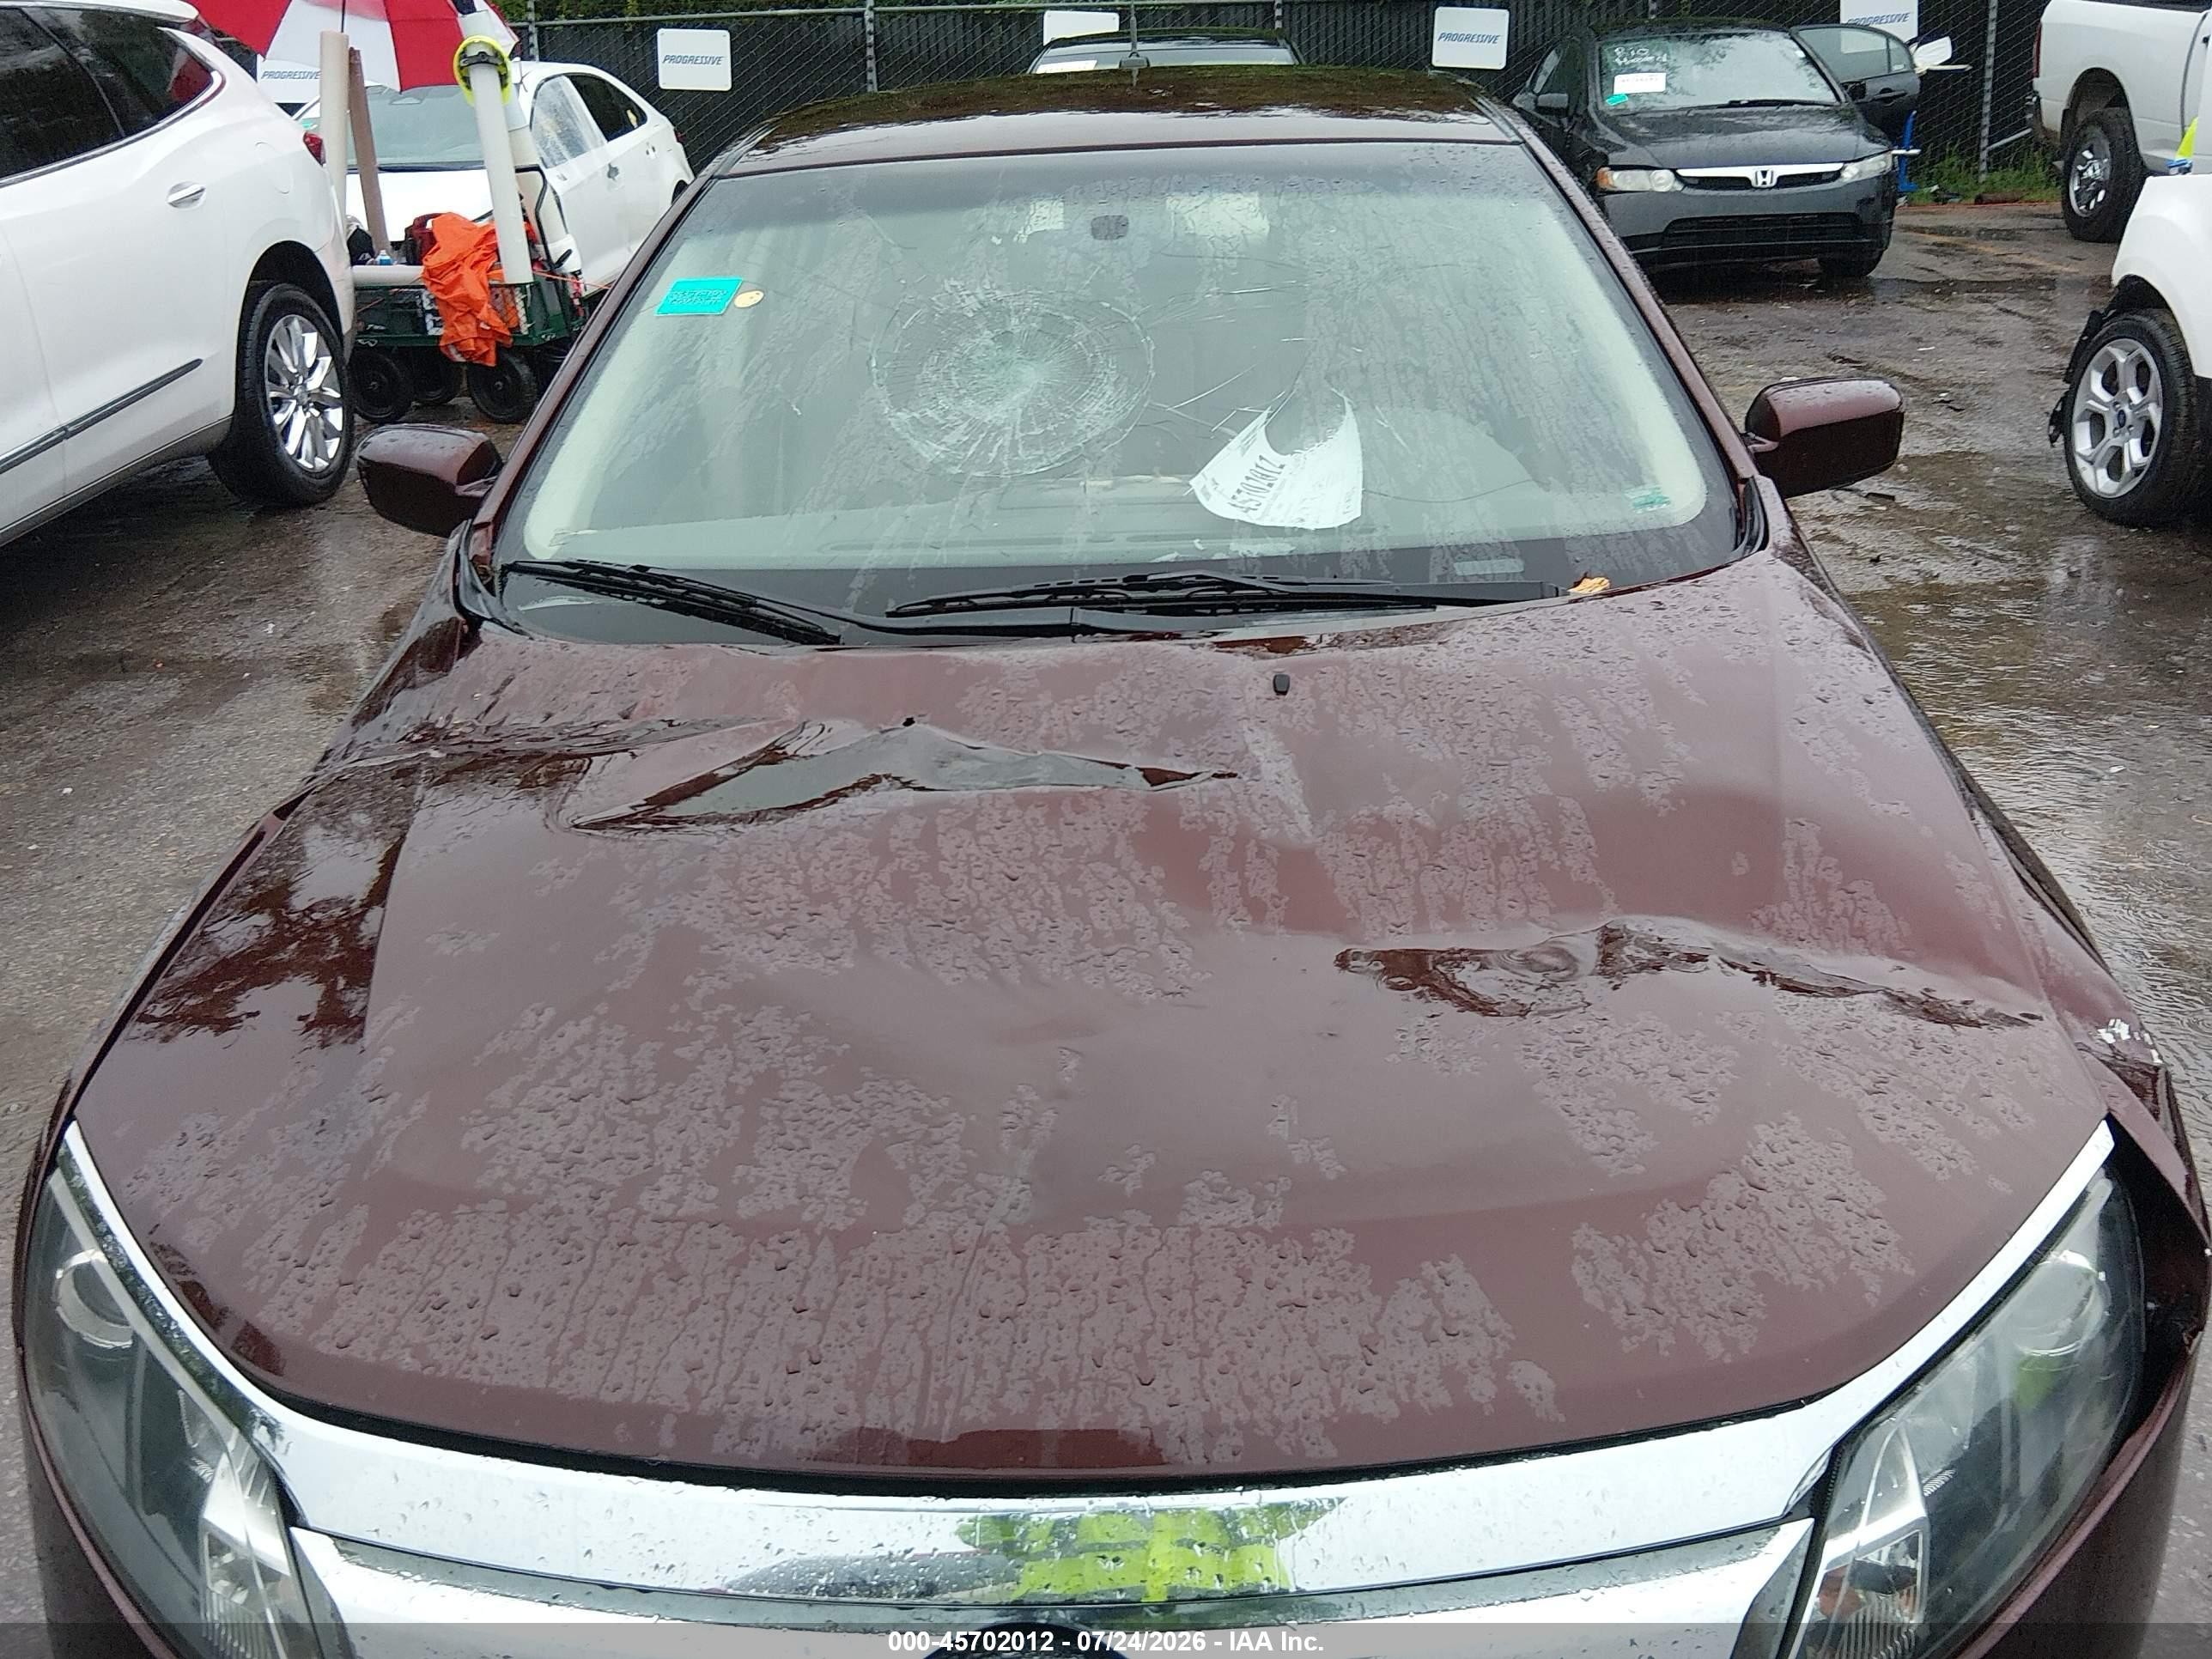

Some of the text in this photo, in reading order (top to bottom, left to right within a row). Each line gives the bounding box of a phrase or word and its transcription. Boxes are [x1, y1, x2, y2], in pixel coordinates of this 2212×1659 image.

[1437, 32, 1500, 45] PROGRESSIVE
[662, 54, 724, 65] PROGRESSIVE
[260, 70, 321, 79] PROGRESSIVE
